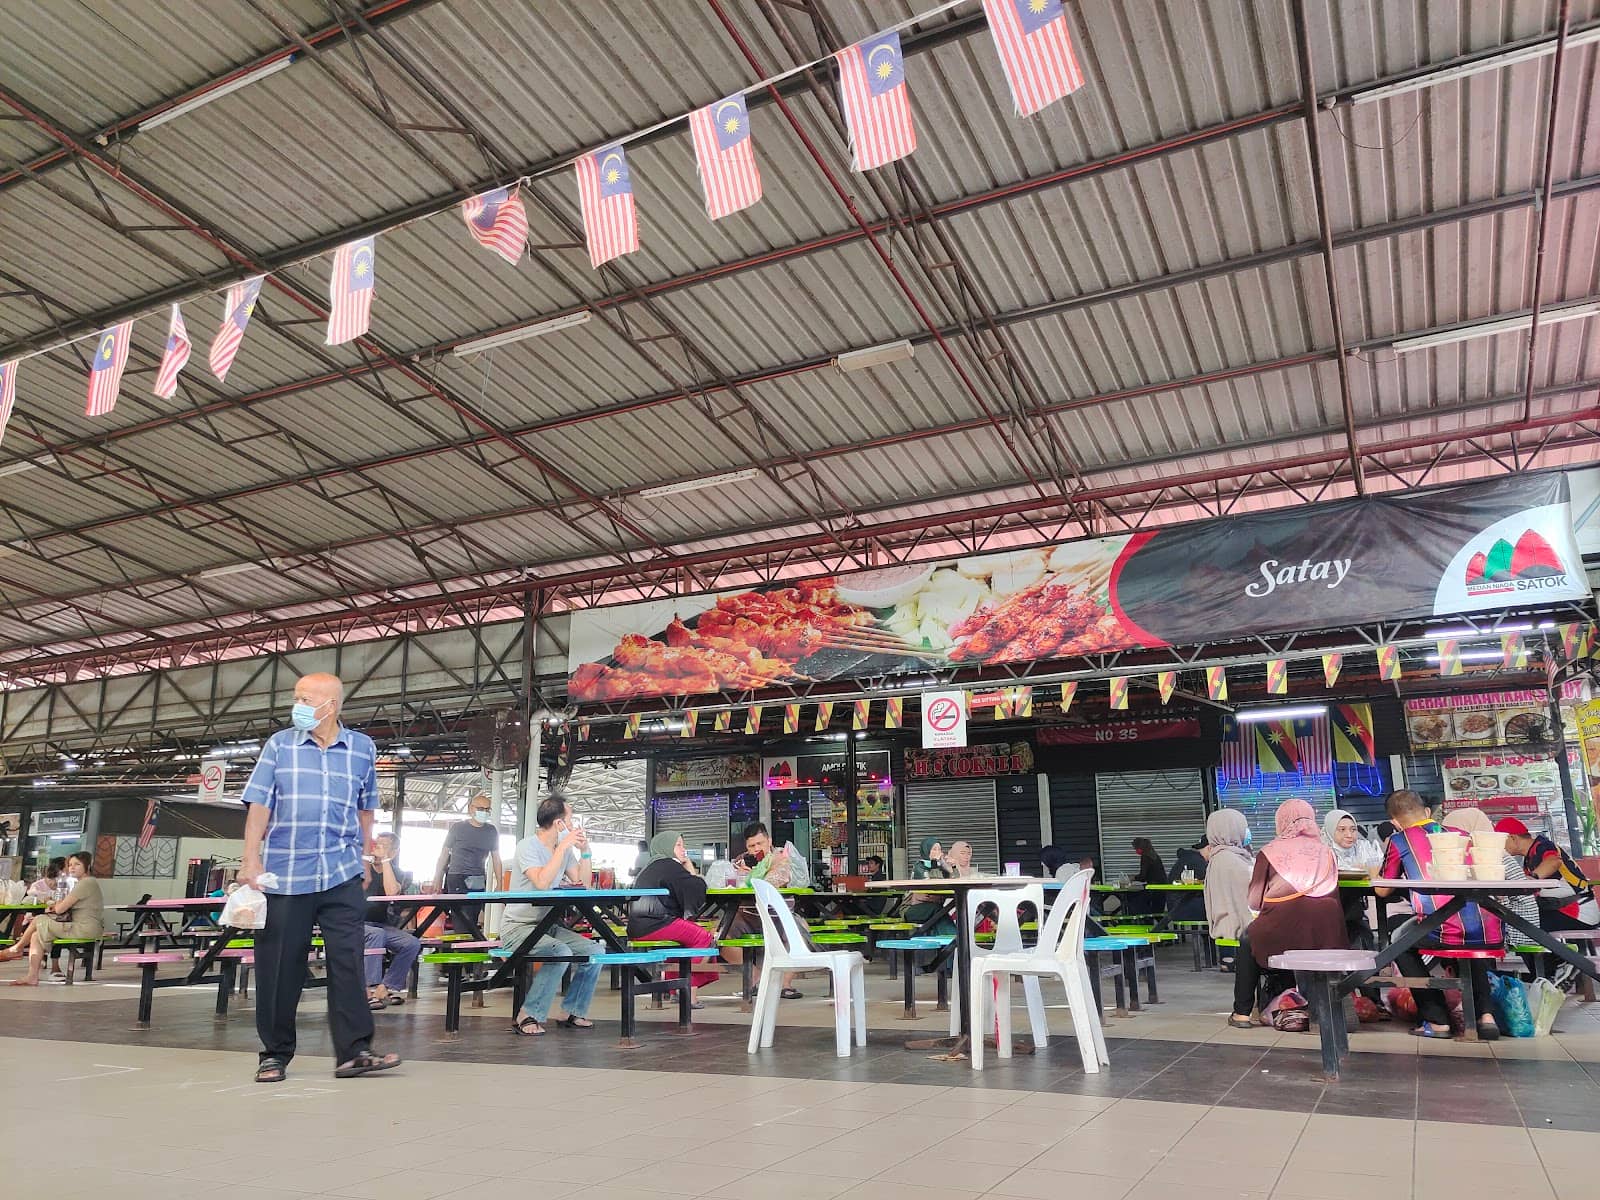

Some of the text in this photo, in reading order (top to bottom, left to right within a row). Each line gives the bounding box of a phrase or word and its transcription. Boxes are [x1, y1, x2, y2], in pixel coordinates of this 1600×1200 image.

[1245, 558, 1352, 597] Satay
[1467, 575, 1568, 592] MEDAN NIAGA SATOK
[1095, 728, 1138, 741] NO 35
[1011, 785, 1023, 794] 36
